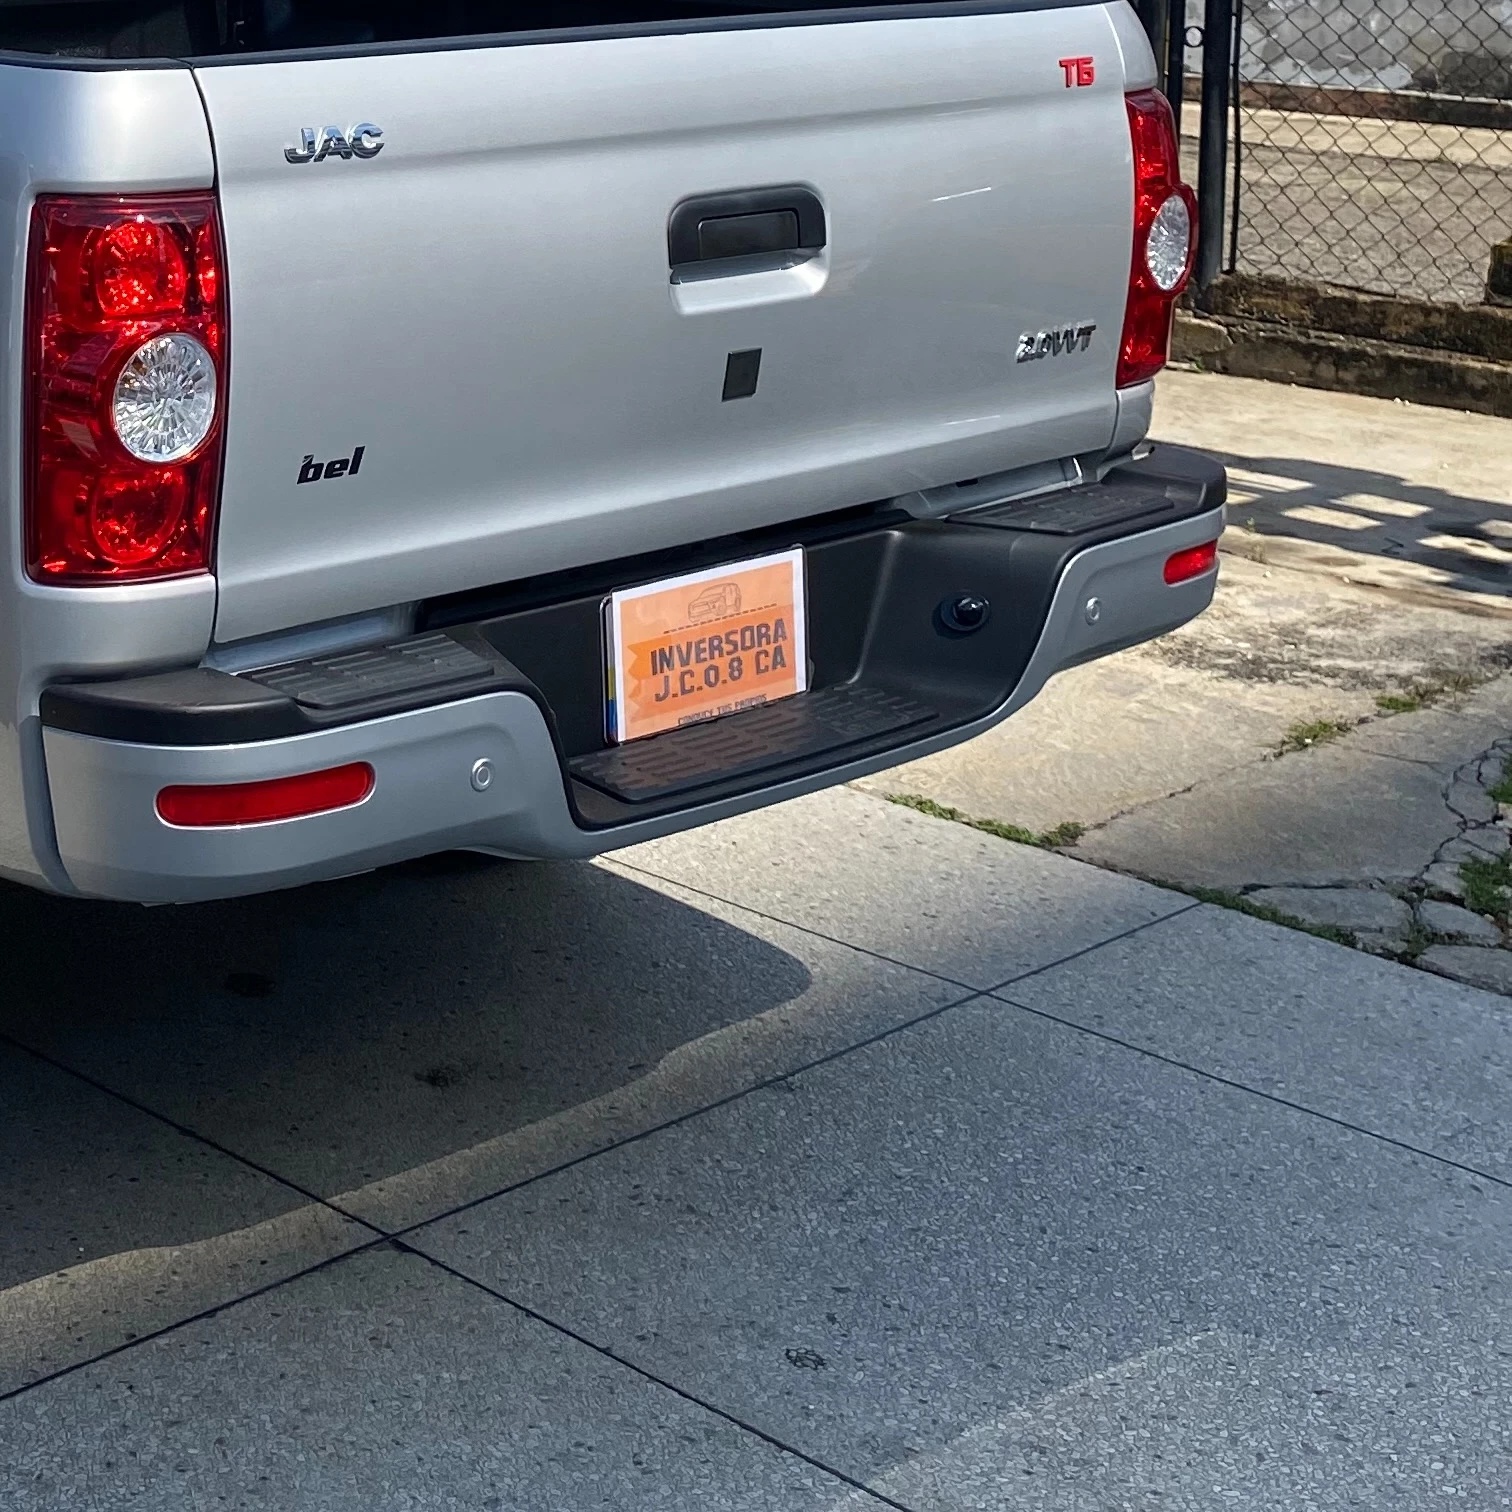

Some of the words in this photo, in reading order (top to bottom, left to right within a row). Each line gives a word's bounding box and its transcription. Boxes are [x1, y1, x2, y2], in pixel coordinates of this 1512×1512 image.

[1059, 56, 1095, 88] T6
[283, 122, 385, 165] JAC
[296, 445, 366, 485] bel
[650, 618, 787, 676] INVERSORA
[754, 645, 787, 675] CA
